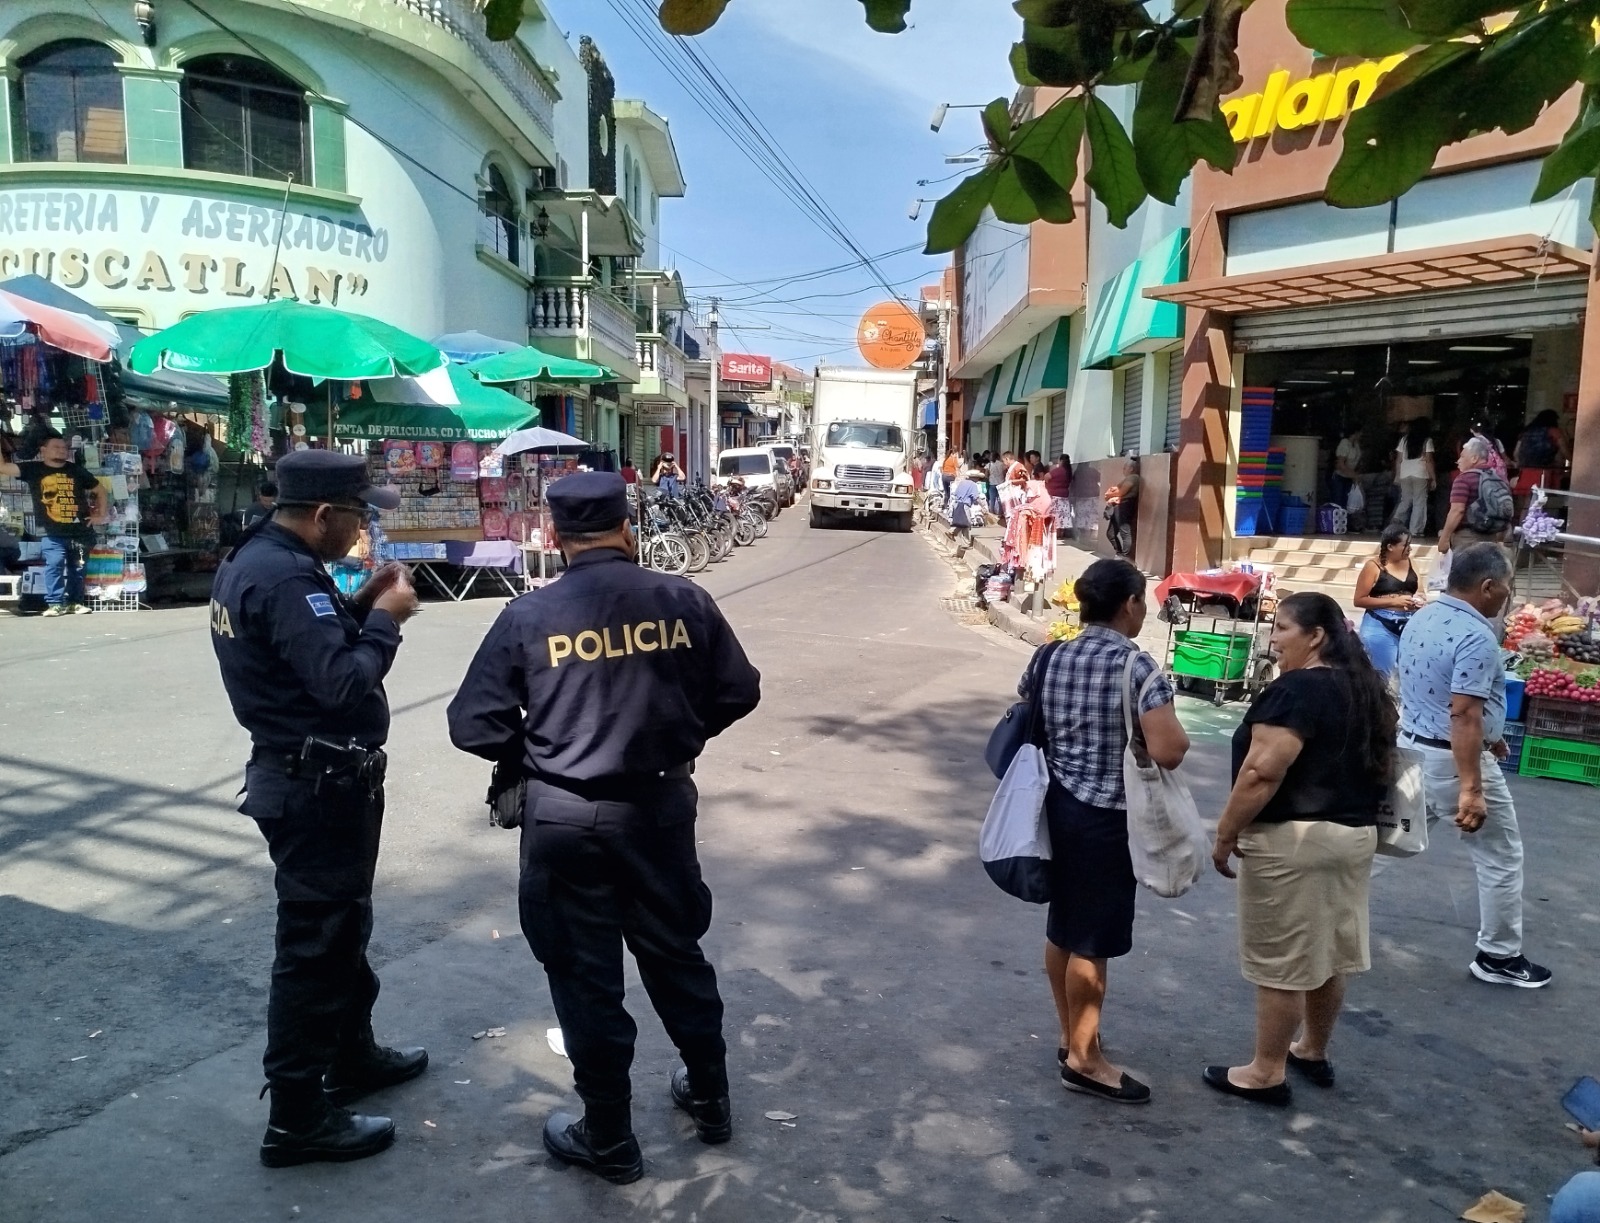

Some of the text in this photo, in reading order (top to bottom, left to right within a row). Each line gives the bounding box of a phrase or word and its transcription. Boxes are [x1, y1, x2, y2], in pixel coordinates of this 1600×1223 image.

[140, 194, 160, 233] Y
[181, 199, 389, 263] ASERRADERO
[728, 360, 764, 375] Sarita
[334, 423, 364, 434] ENTA
[368, 424, 382, 435] DE
[441, 427, 454, 437] CD
[456, 428, 462, 437] Y
[464, 428, 497, 438] MUCHO
[548, 618, 692, 668] POLICIA
